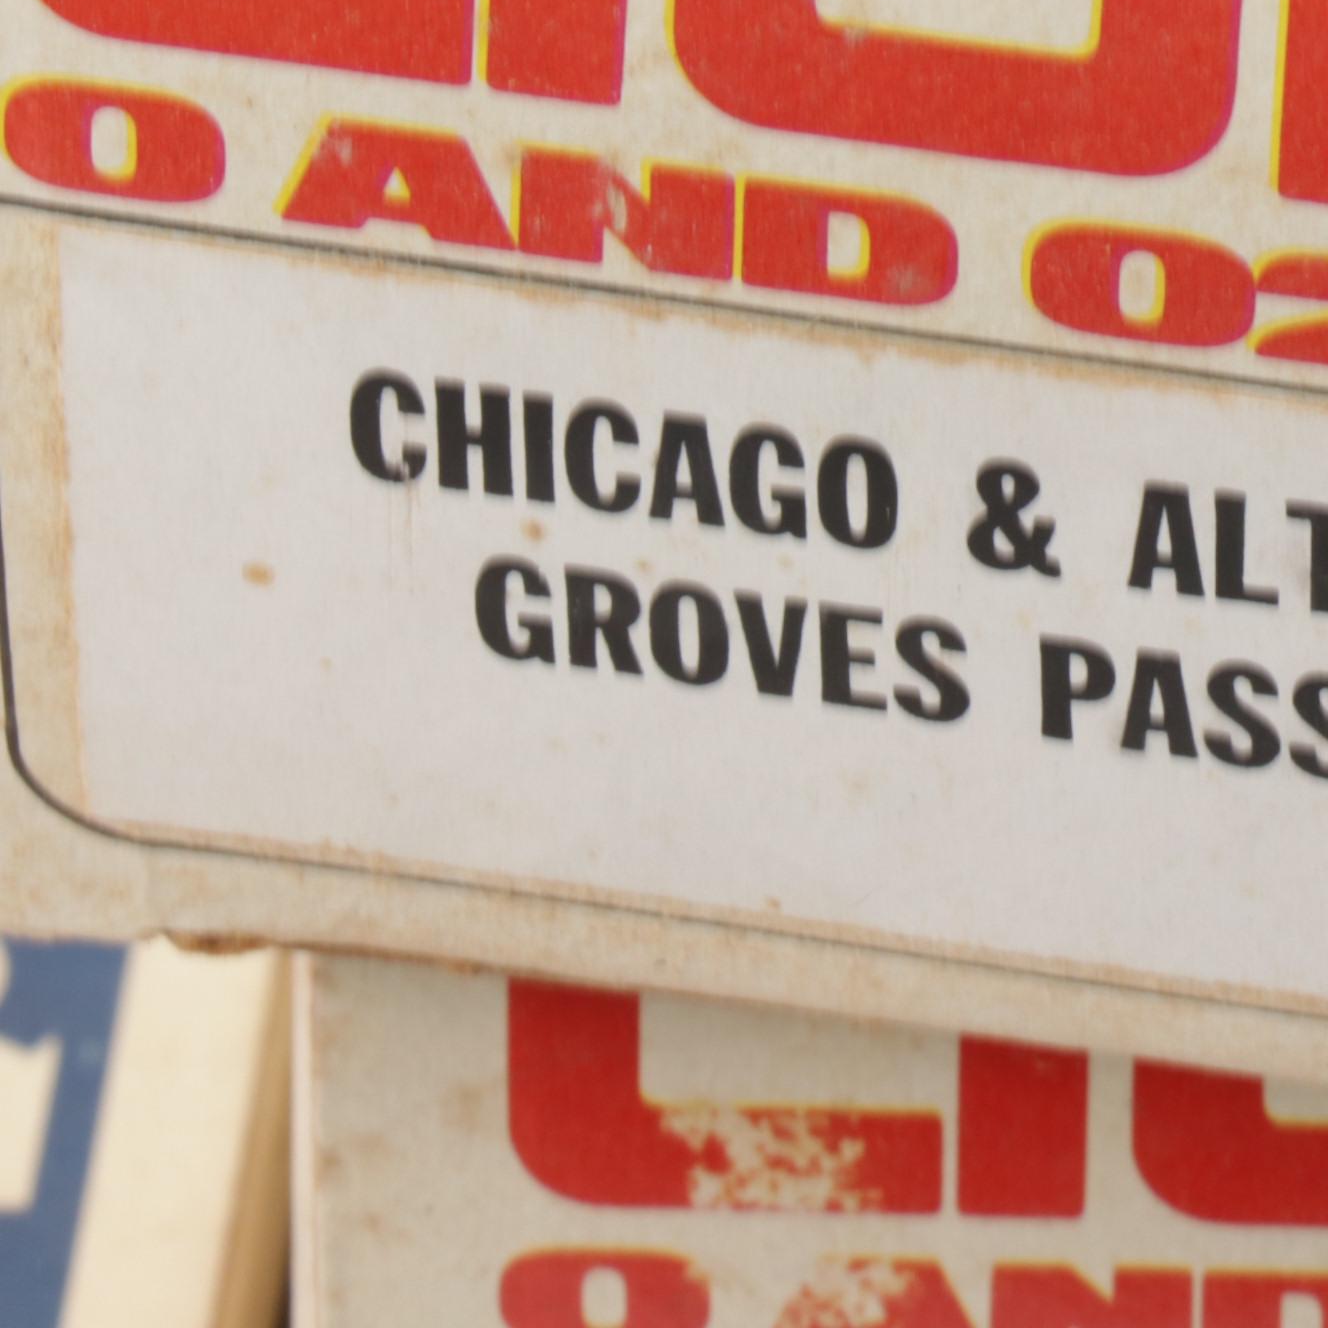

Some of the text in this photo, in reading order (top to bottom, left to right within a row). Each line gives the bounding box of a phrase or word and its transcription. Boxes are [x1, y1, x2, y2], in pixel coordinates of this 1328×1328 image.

[272, 110, 958, 308] AND
[348, 369, 900, 552] CHICAGO
[964, 458, 1063, 580] &
[473, 555, 972, 725] GROVES
